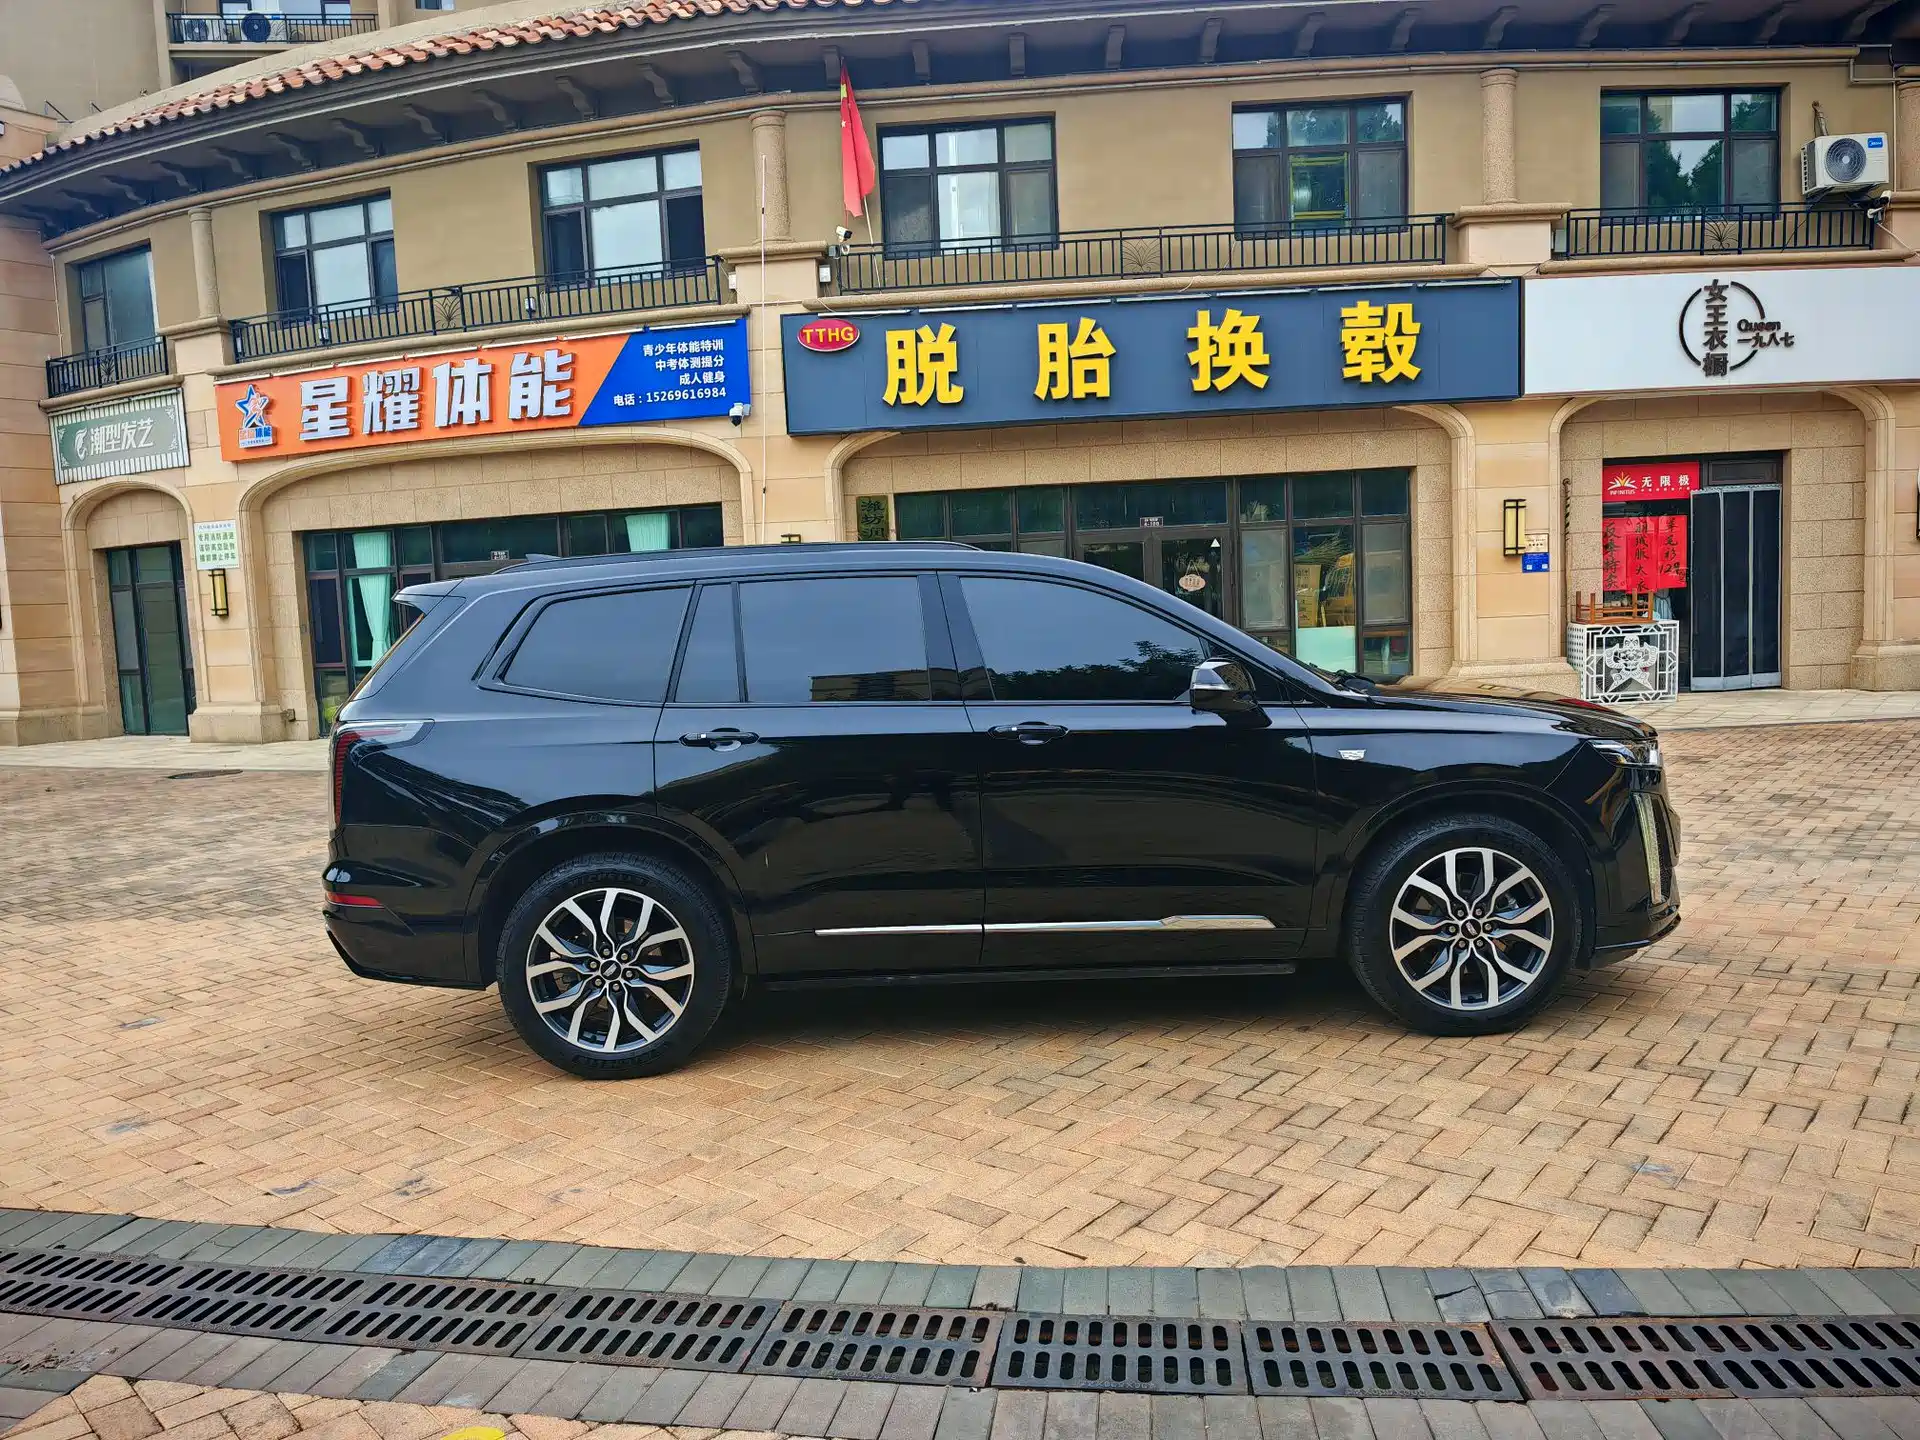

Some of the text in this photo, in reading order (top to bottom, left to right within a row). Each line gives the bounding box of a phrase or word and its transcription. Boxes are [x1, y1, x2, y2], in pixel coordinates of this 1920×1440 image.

[1702, 278, 1729, 377] 女王衣橱
[1737, 318, 1781, 333] Queen
[802, 326, 854, 344] TTHG
[1737, 332, 1795, 348] 一九八七
[643, 338, 723, 357] 青少年体能特训
[882, 301, 1421, 407] 脱胎换毂
[655, 355, 725, 372] 中考体测提分
[679, 370, 726, 386] 成人健身
[299, 348, 575, 442] 星耀体能
[90, 417, 154, 456] 潮型发艺
[1641, 474, 1690, 488] 无限极
